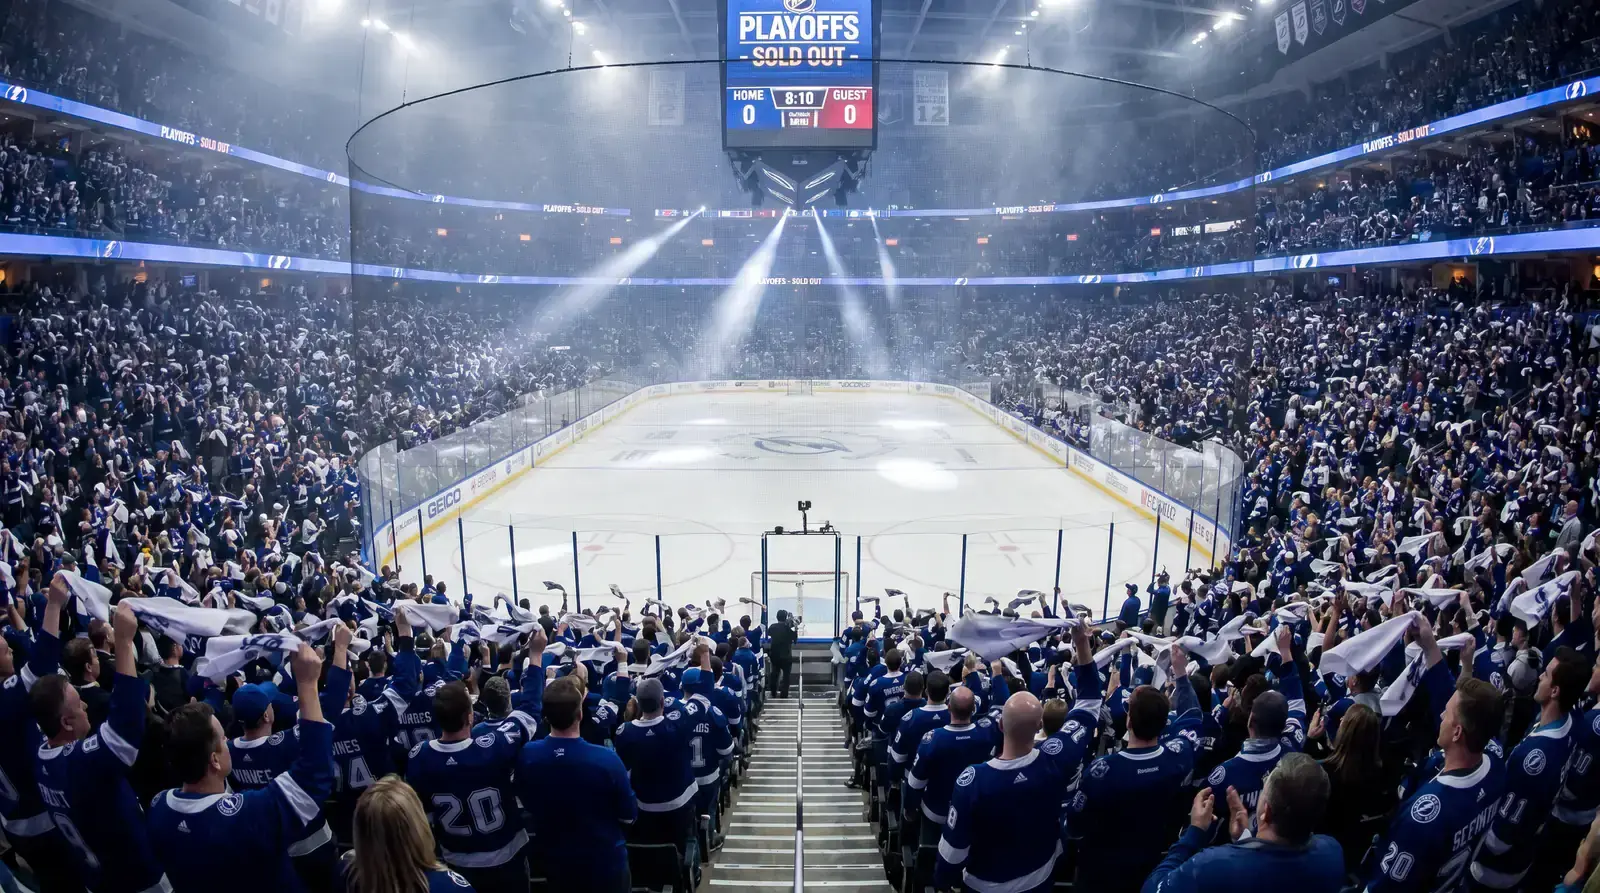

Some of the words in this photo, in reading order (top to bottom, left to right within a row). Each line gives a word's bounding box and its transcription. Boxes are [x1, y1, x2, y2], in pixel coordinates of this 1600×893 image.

[739, 15, 859, 40] PLAYOFFS
[752, 46, 802, 67] SOLD
[807, 46, 846, 66] OUT
[733, 90, 765, 101] HOME
[784, 91, 814, 105] 8:10
[833, 90, 867, 101] GUEST
[742, 104, 756, 125] 0
[844, 104, 857, 125] 0
[916, 105, 946, 123] 12
[161, 125, 195, 145] PLAYOFFS
[200, 136, 217, 151] SOLD
[217, 141, 230, 153] OUT
[1363, 135, 1393, 154] PLAYOFFS
[1397, 129, 1415, 143] SOLD
[1415, 125, 1430, 138] OUT
[791, 277, 809, 285] SOLD
[809, 277, 822, 285] OUT
[427, 488, 461, 519] GEICO
[431, 786, 507, 838] 20
[1499, 791, 1528, 825] 11
[1380, 841, 1416, 883] 20
